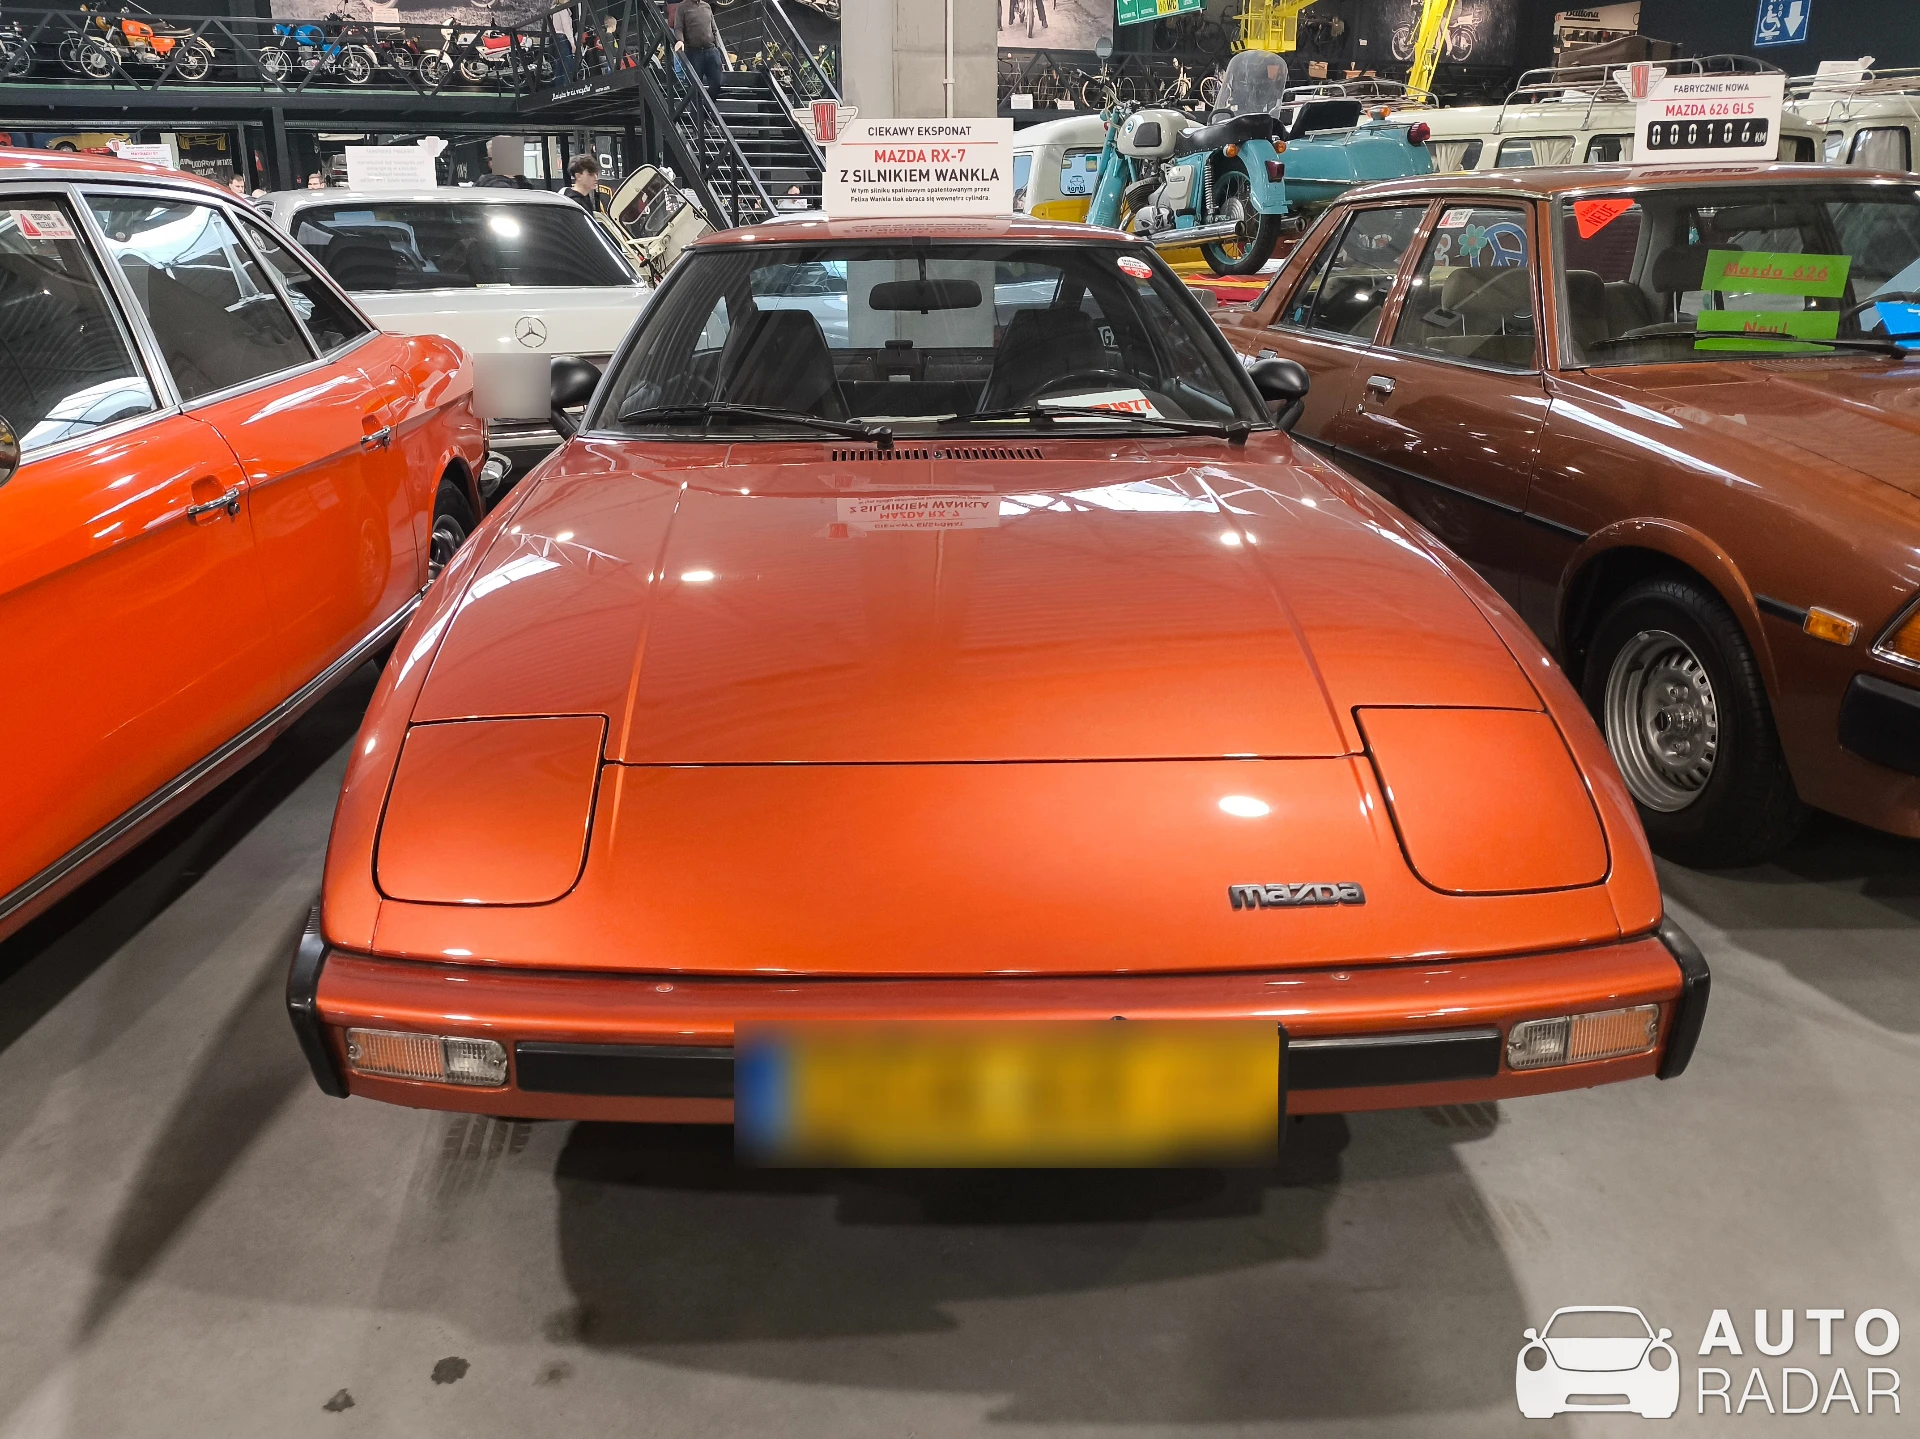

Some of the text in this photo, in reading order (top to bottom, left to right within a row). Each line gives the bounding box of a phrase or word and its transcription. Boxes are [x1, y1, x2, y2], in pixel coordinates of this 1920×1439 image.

[1673, 83, 1750, 93] FABRYCZNIE NOWA
[1665, 103, 1754, 116] MAZDA 626 GLS
[867, 126, 972, 136] CIEKAWY EKSPONAT
[1754, 131, 1767, 143] KM
[874, 148, 966, 163] MAZDA RX-7
[840, 168, 1000, 183] Z SILNIKIEM WANKLA
[927, 186, 973, 194] opatentowanym
[935, 195, 964, 203] wewnątrz
[1584, 203, 1619, 227] NEUE
[1723, 262, 1829, 281] Mazda 626
[1109, 398, 1153, 412] 1977
[1229, 882, 1366, 911] mazda
